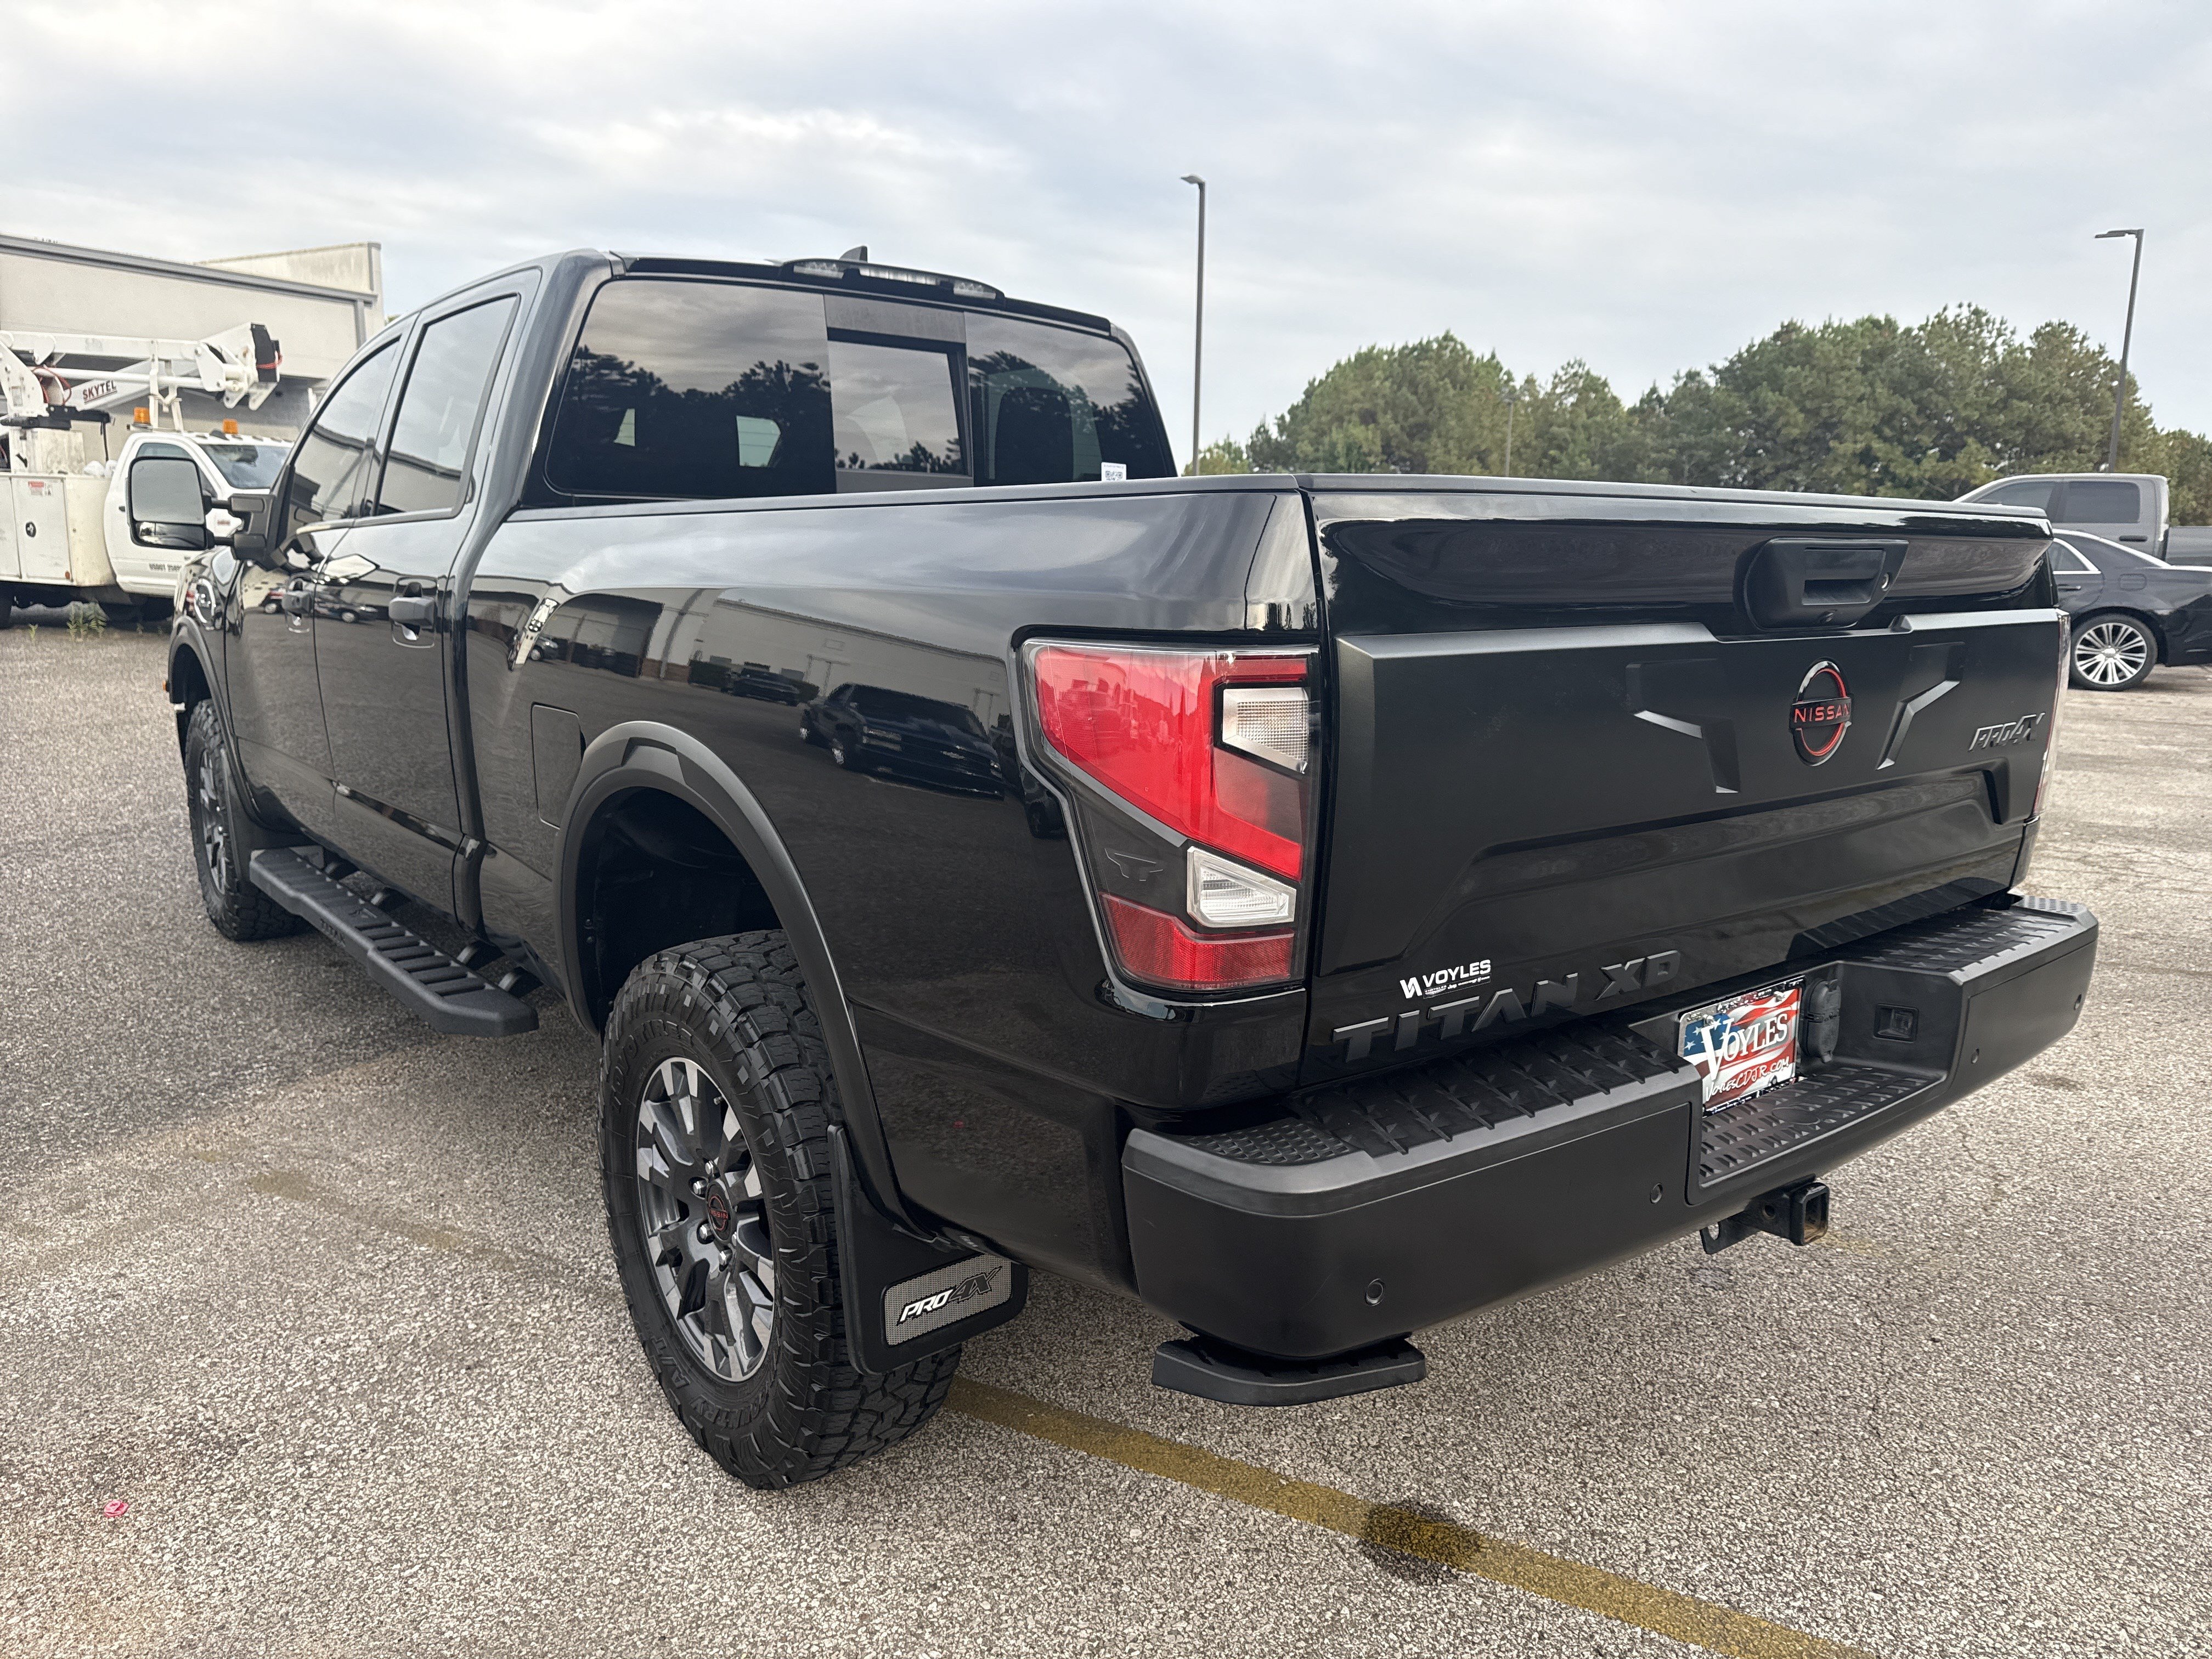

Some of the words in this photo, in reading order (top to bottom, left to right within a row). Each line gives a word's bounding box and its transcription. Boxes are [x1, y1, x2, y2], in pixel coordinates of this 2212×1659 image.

[82, 380, 117, 400] SKYTEL
[1793, 704, 1849, 723] NISSAN
[1422, 959, 1491, 988] VOYLES
[1330, 972, 1578, 1063] TITAN
[1595, 950, 1681, 1001] XD
[1700, 1013, 1788, 1081] VOYLES
